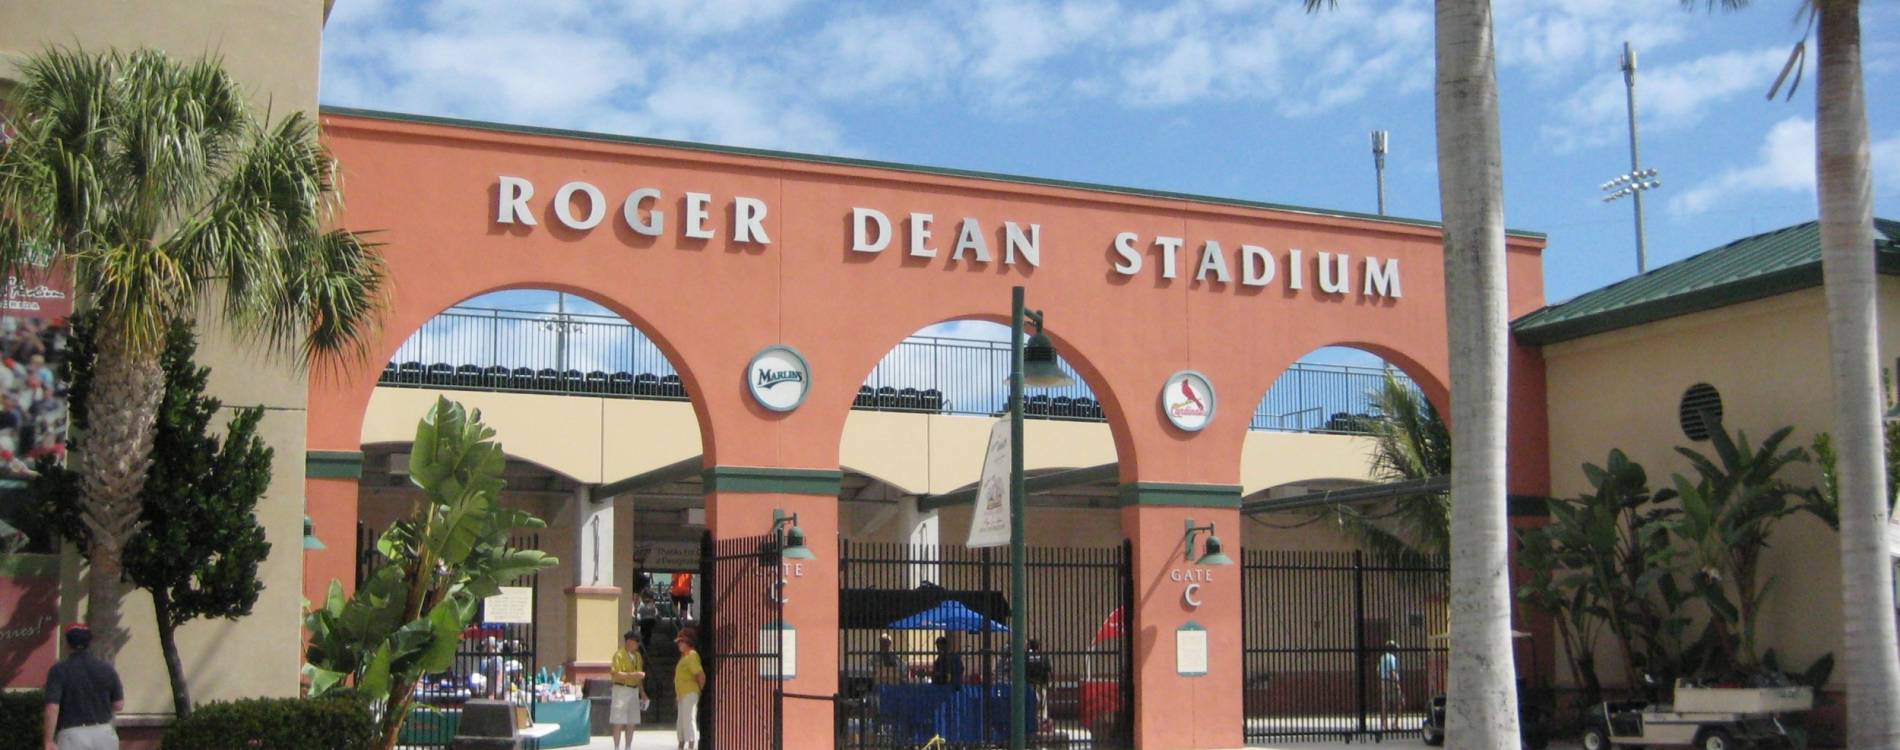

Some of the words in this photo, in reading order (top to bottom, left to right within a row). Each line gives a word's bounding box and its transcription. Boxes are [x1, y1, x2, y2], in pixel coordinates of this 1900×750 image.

[497, 176, 771, 244] ROGER
[852, 207, 1040, 267] DEAN
[1115, 232, 1402, 298] STADIUM
[1171, 568, 1214, 582] GATE
[1184, 583, 1202, 607] C
